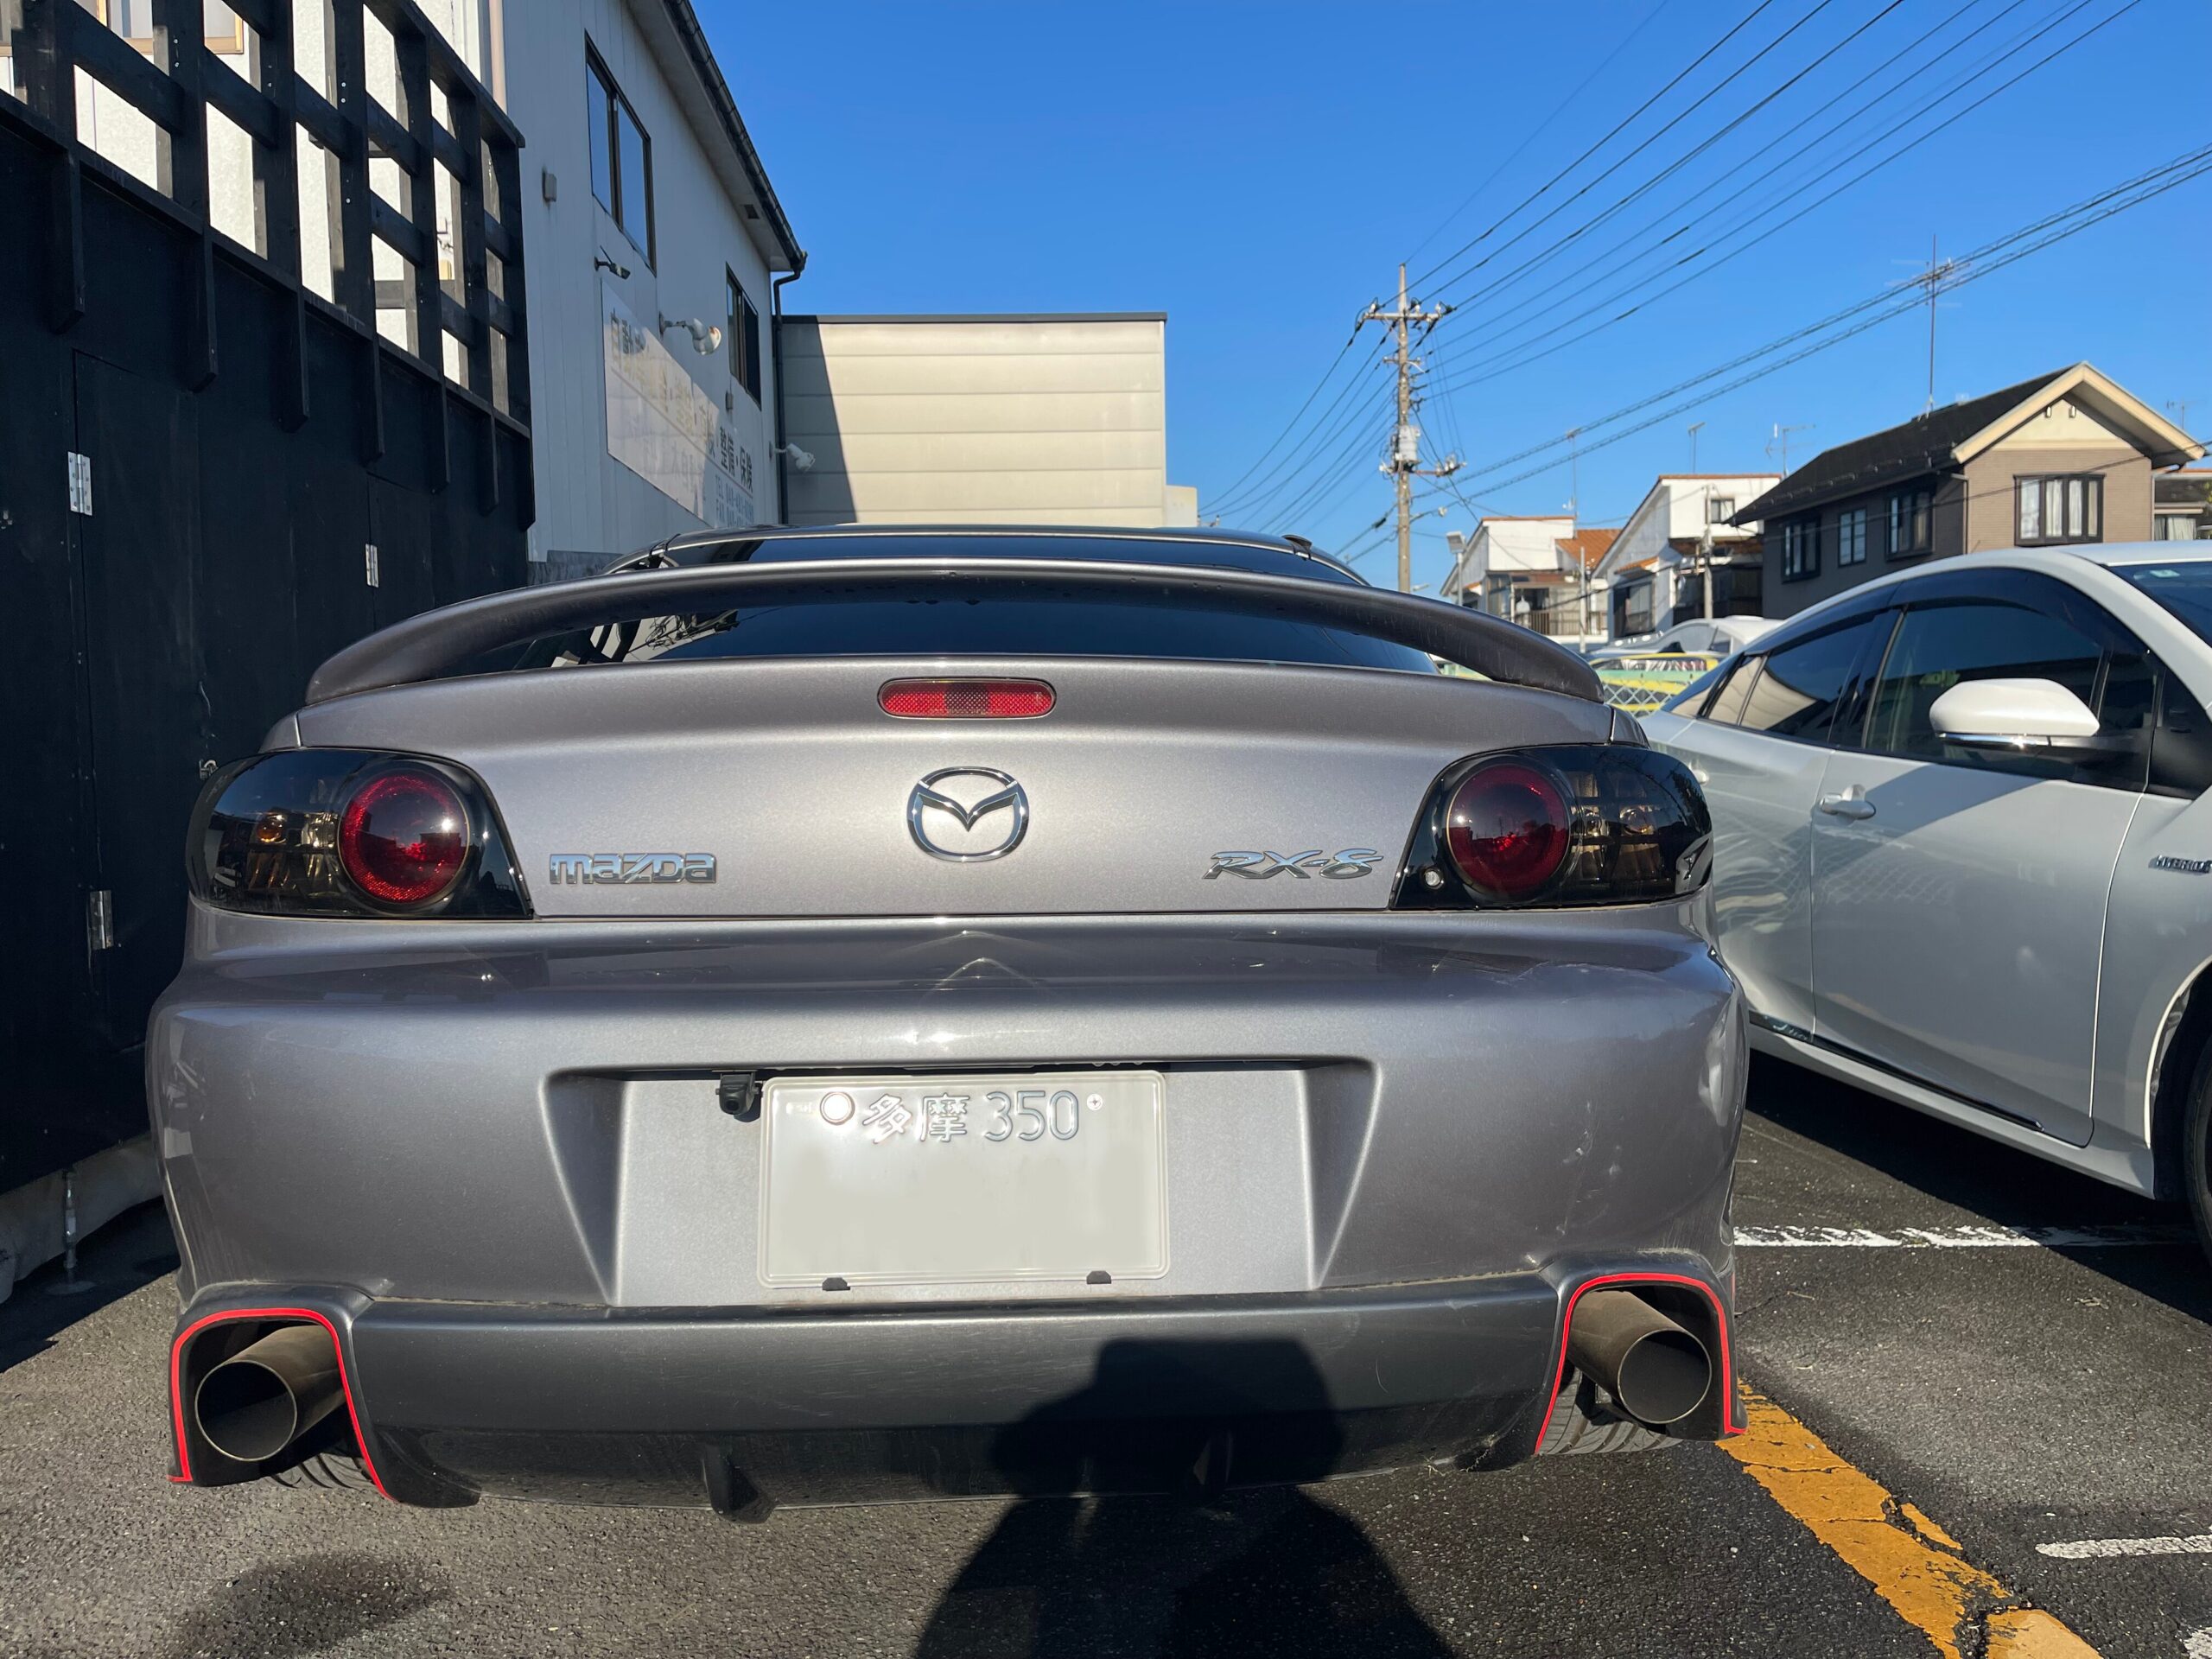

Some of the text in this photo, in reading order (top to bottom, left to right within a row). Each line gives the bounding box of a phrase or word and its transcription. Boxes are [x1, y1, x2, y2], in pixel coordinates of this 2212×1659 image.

[1202, 848, 1384, 880] RX-8
[861, 1090, 1080, 1144] 多摩 350
